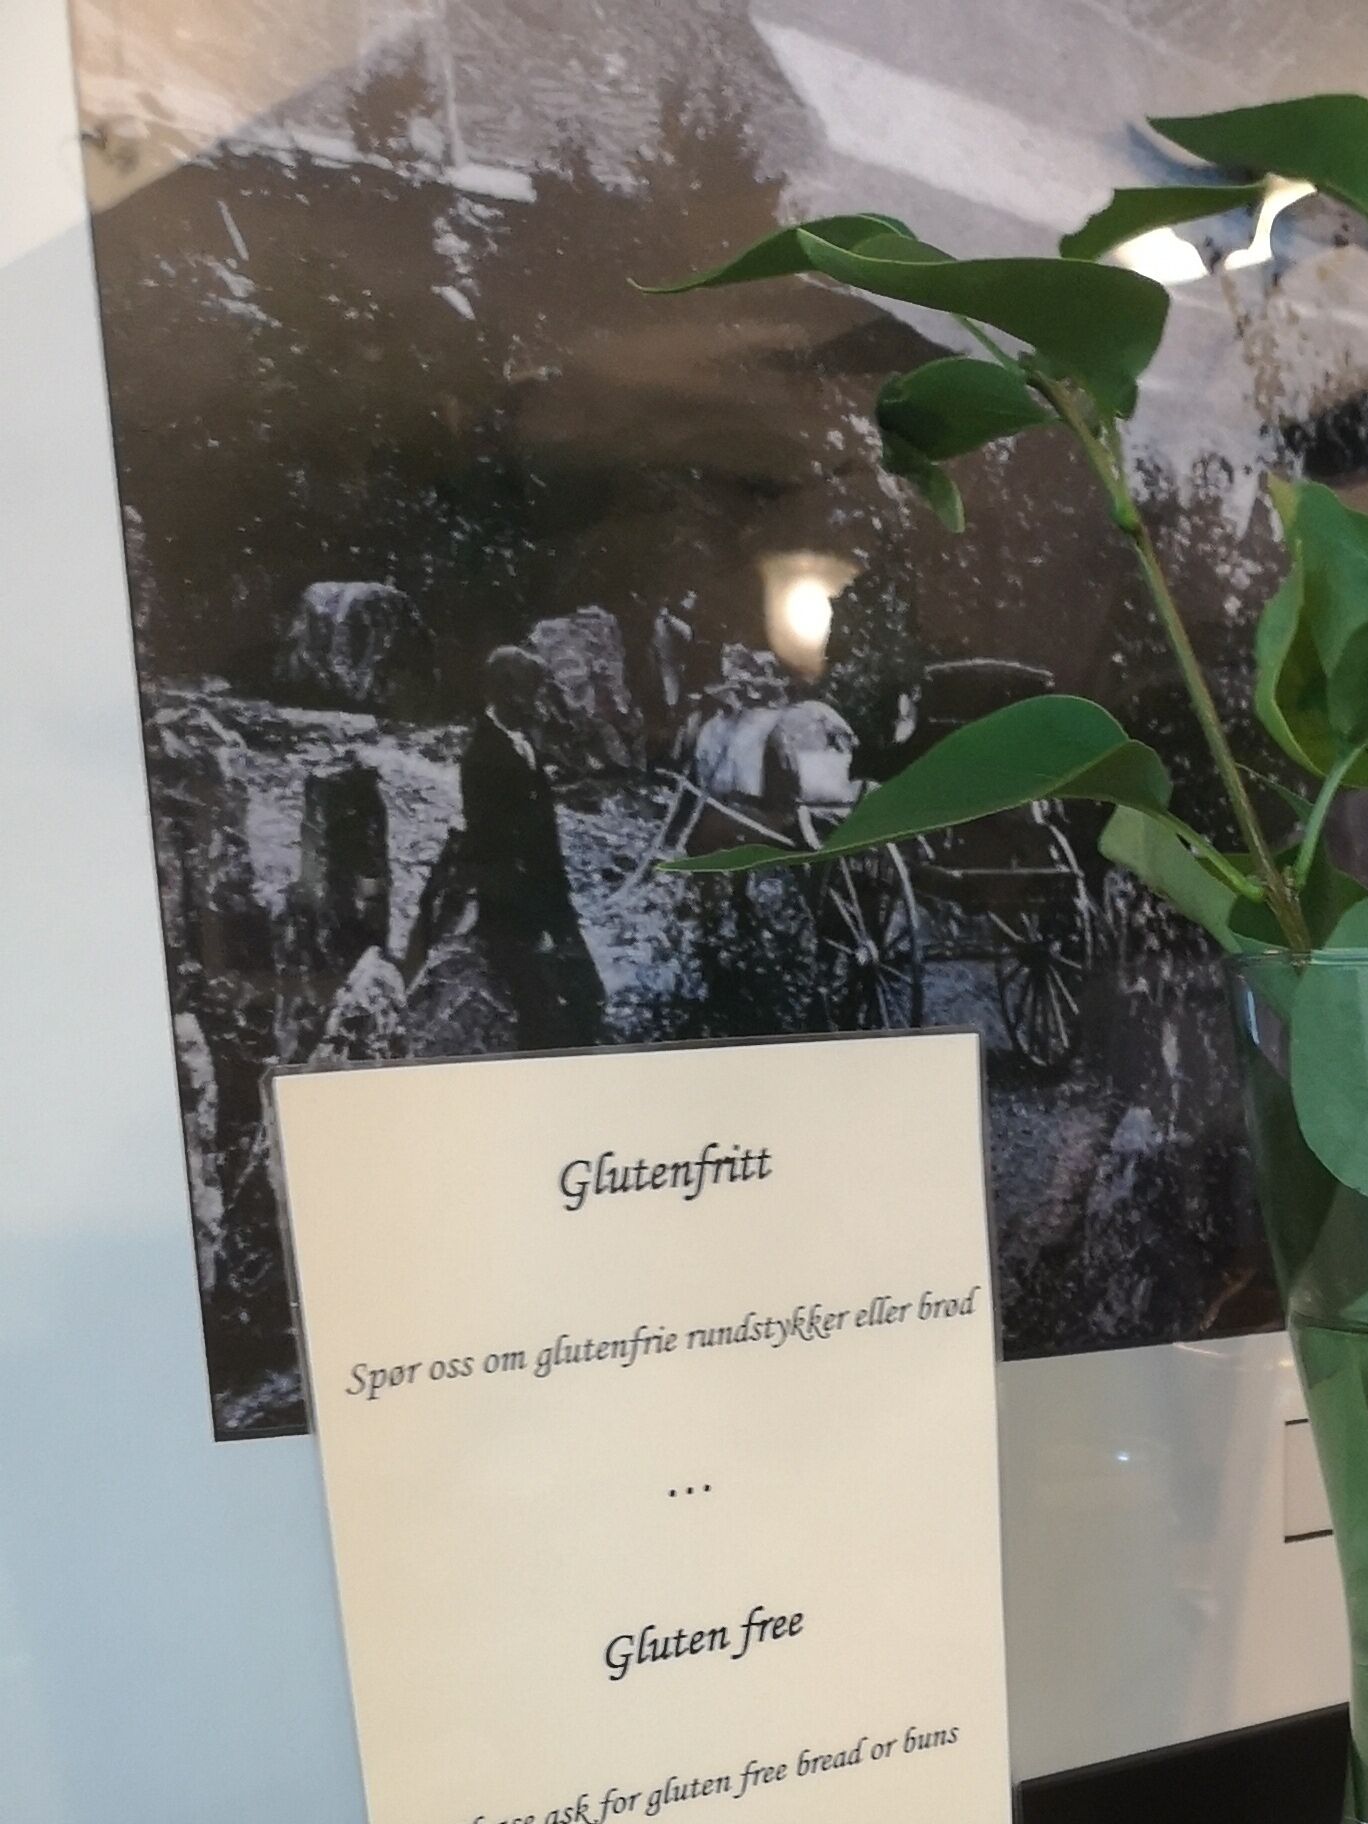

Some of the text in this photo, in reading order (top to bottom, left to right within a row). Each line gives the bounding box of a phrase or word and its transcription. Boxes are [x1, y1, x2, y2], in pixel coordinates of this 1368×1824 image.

[560, 1141, 773, 1212] Glutenfritt
[345, 1285, 982, 1401] Spør oss om glutenfrie rundstykker eller brød
[604, 1604, 805, 1682] Gluten free
[644, 1775, 733, 1817] gluten
[733, 1759, 788, 1800] free
[795, 1735, 869, 1778] bread
[870, 1737, 899, 1761] or
[902, 1725, 960, 1755] buns
